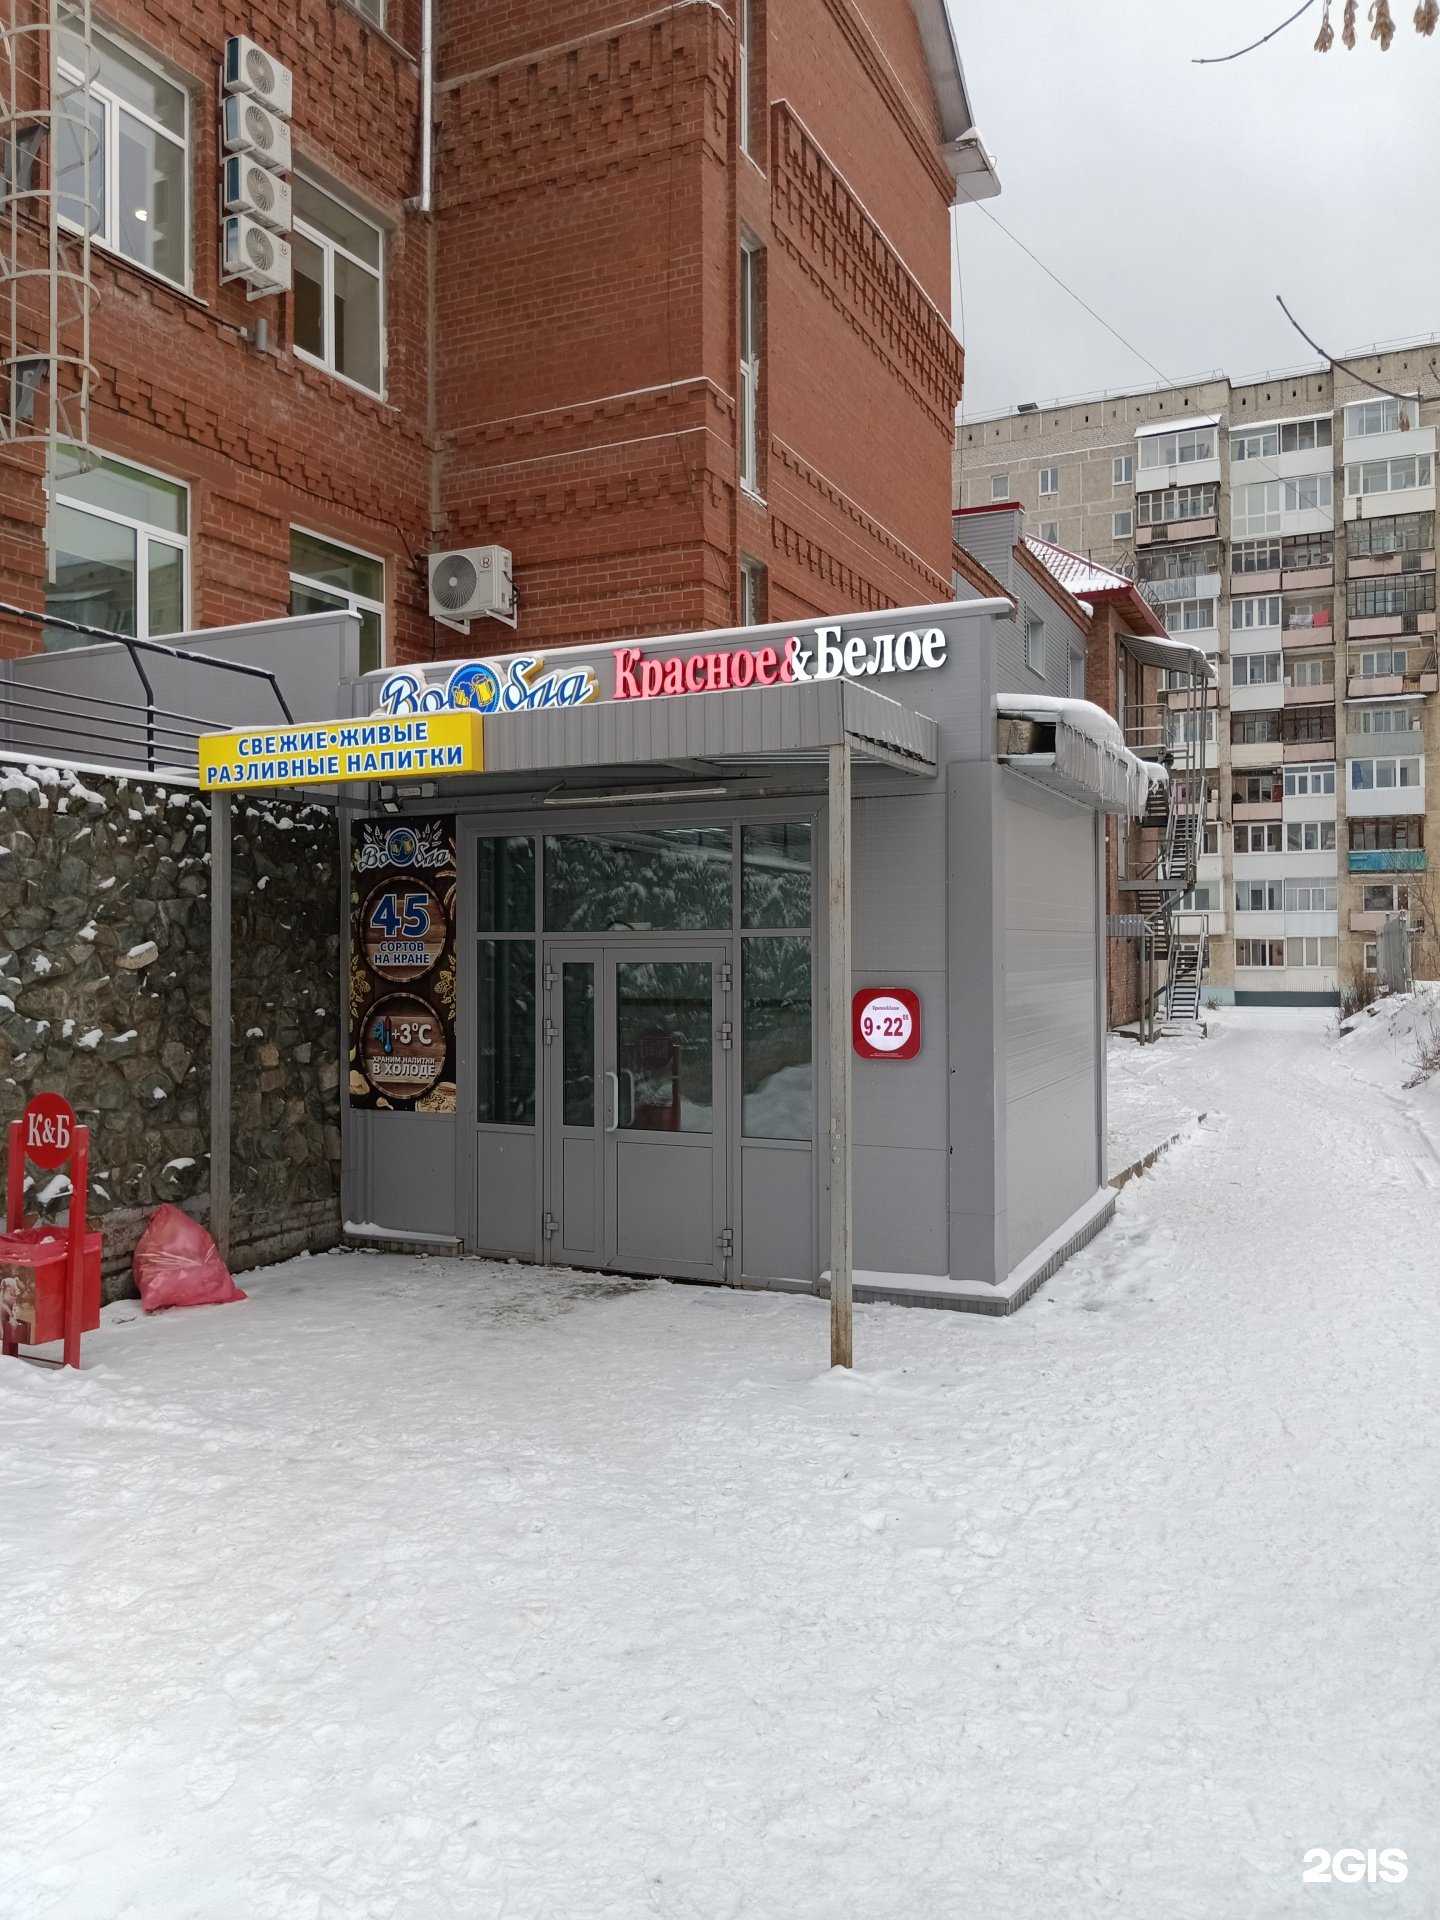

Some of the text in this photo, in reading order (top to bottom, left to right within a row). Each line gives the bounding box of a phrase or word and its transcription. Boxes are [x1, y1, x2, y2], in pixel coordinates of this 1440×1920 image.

[207, 746, 463, 784] РАЗЛИВНЫЕ НАПИТКИ
[370, 893, 430, 937] 45
[380, 942, 424, 952] СОРТОВ
[374, 953, 430, 964] НА КРАНЕ
[402, 1057, 435, 1065] НАПИТКИ
[373, 1064, 436, 1078] В ХОЛОДЕ
[27, 1112, 70, 1149] К&Б
